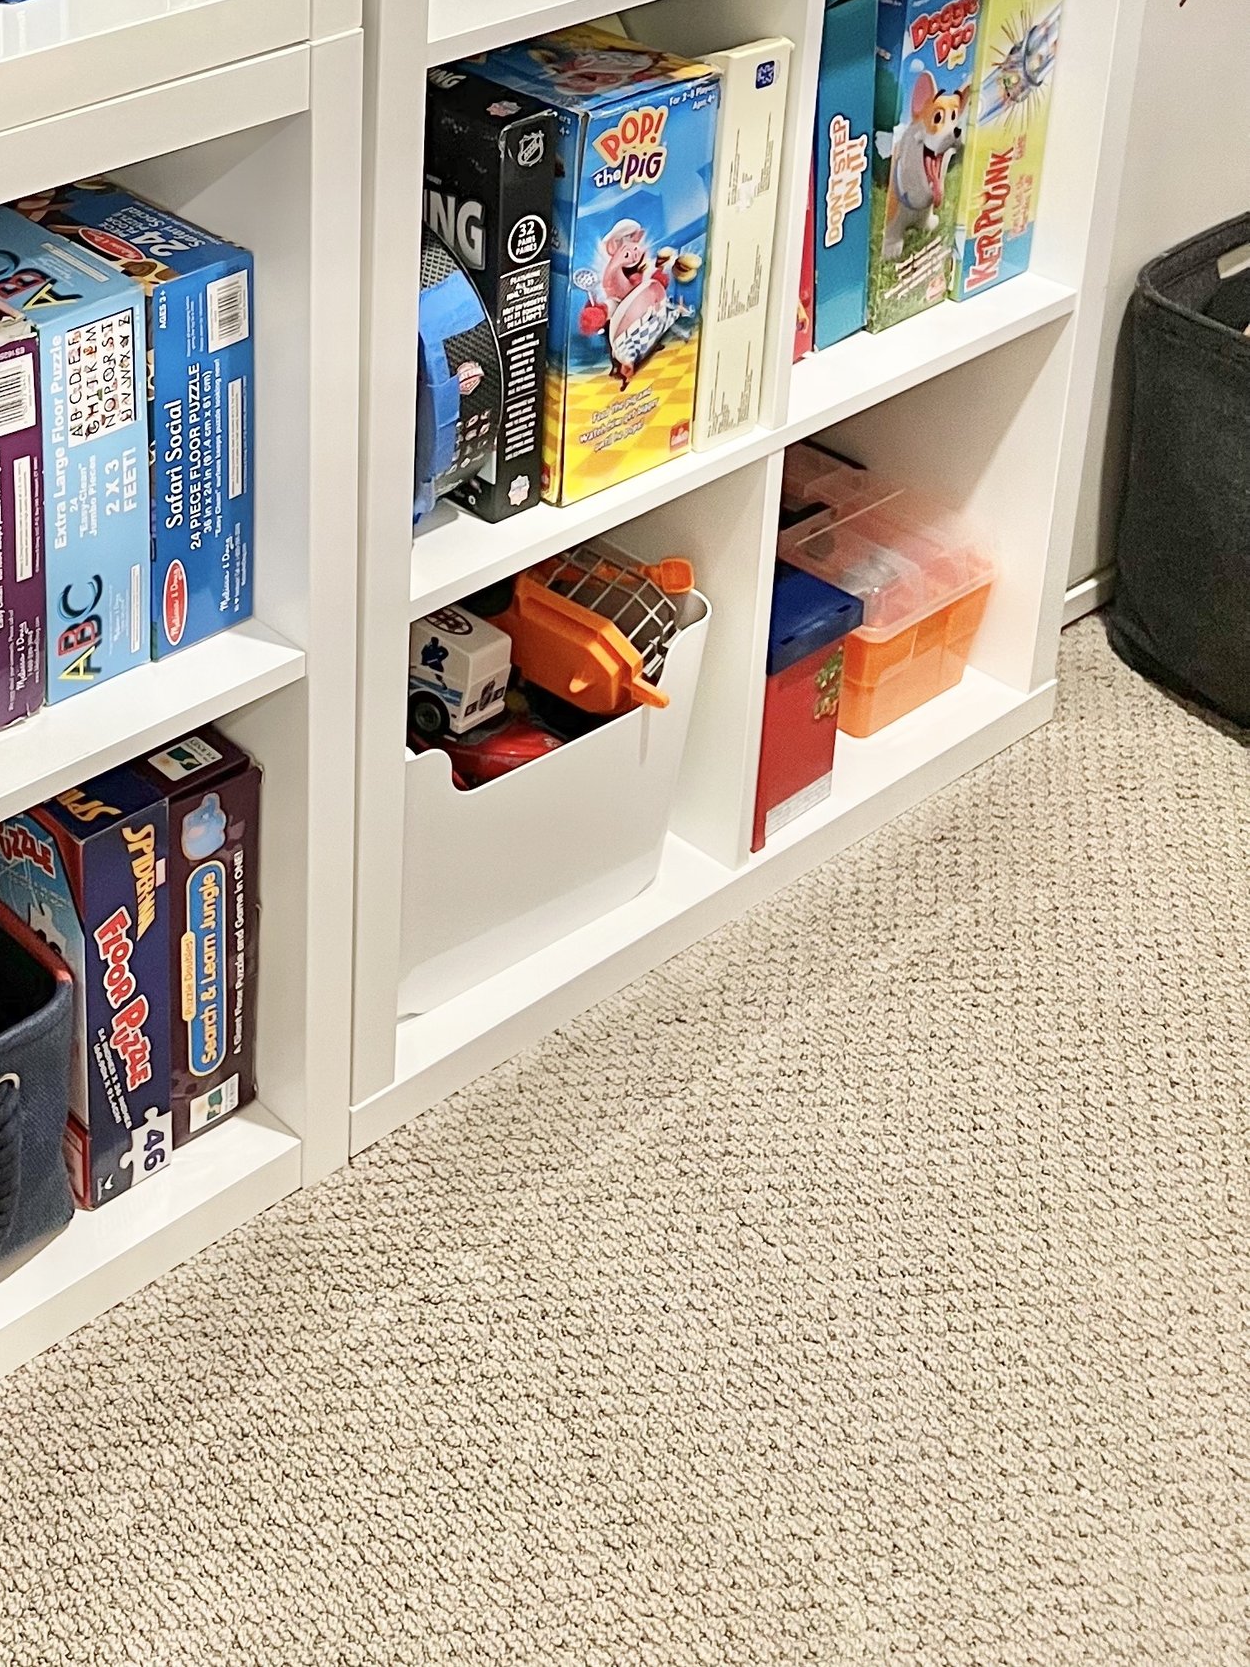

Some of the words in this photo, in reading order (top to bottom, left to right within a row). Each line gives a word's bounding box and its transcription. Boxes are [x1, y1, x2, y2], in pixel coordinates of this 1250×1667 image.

[934, 23, 975, 65] Doo
[601, 112, 664, 162] POP!
[833, 119, 847, 175] STEP
[846, 138, 866, 173] IT!
[593, 168, 622, 187] the
[844, 177, 859, 209] IN
[519, 221, 535, 238] 32
[828, 178, 844, 243] DON'T
[158, 289, 166, 304] 3+
[159, 305, 167, 329] AGES
[50, 335, 64, 393] Puzzle
[189, 363, 200, 422] PUZZLE
[51, 399, 65, 443] Floor
[164, 399, 183, 460] Social
[52, 448, 68, 497] Large
[105, 459, 119, 472] 3
[189, 425, 201, 478] FLOOR
[88, 455, 97, 494] Pieces
[106, 478, 119, 495] X
[123, 448, 137, 511] FEET!
[165, 465, 184, 528] Safari
[54, 501, 67, 549] Extra
[70, 497, 79, 512] 24
[89, 496, 97, 536] Jumbo
[106, 500, 120, 515] 2
[189, 483, 202, 527] PIECE
[189, 532, 202, 550] 24
[57, 573, 103, 681] ABC
[121, 823, 157, 942] SPIDER-MAN
[199, 872, 220, 930] Jungle
[183, 937, 193, 981] Doubles!
[202, 933, 218, 984] Learn
[96, 908, 132, 1007] FLOOR
[114, 1000, 150, 1089] PUZZLE
[184, 983, 194, 1016] Puzzle
[200, 986, 217, 1000] &
[201, 1004, 218, 1064] Search
[139, 1129, 166, 1170] 46
